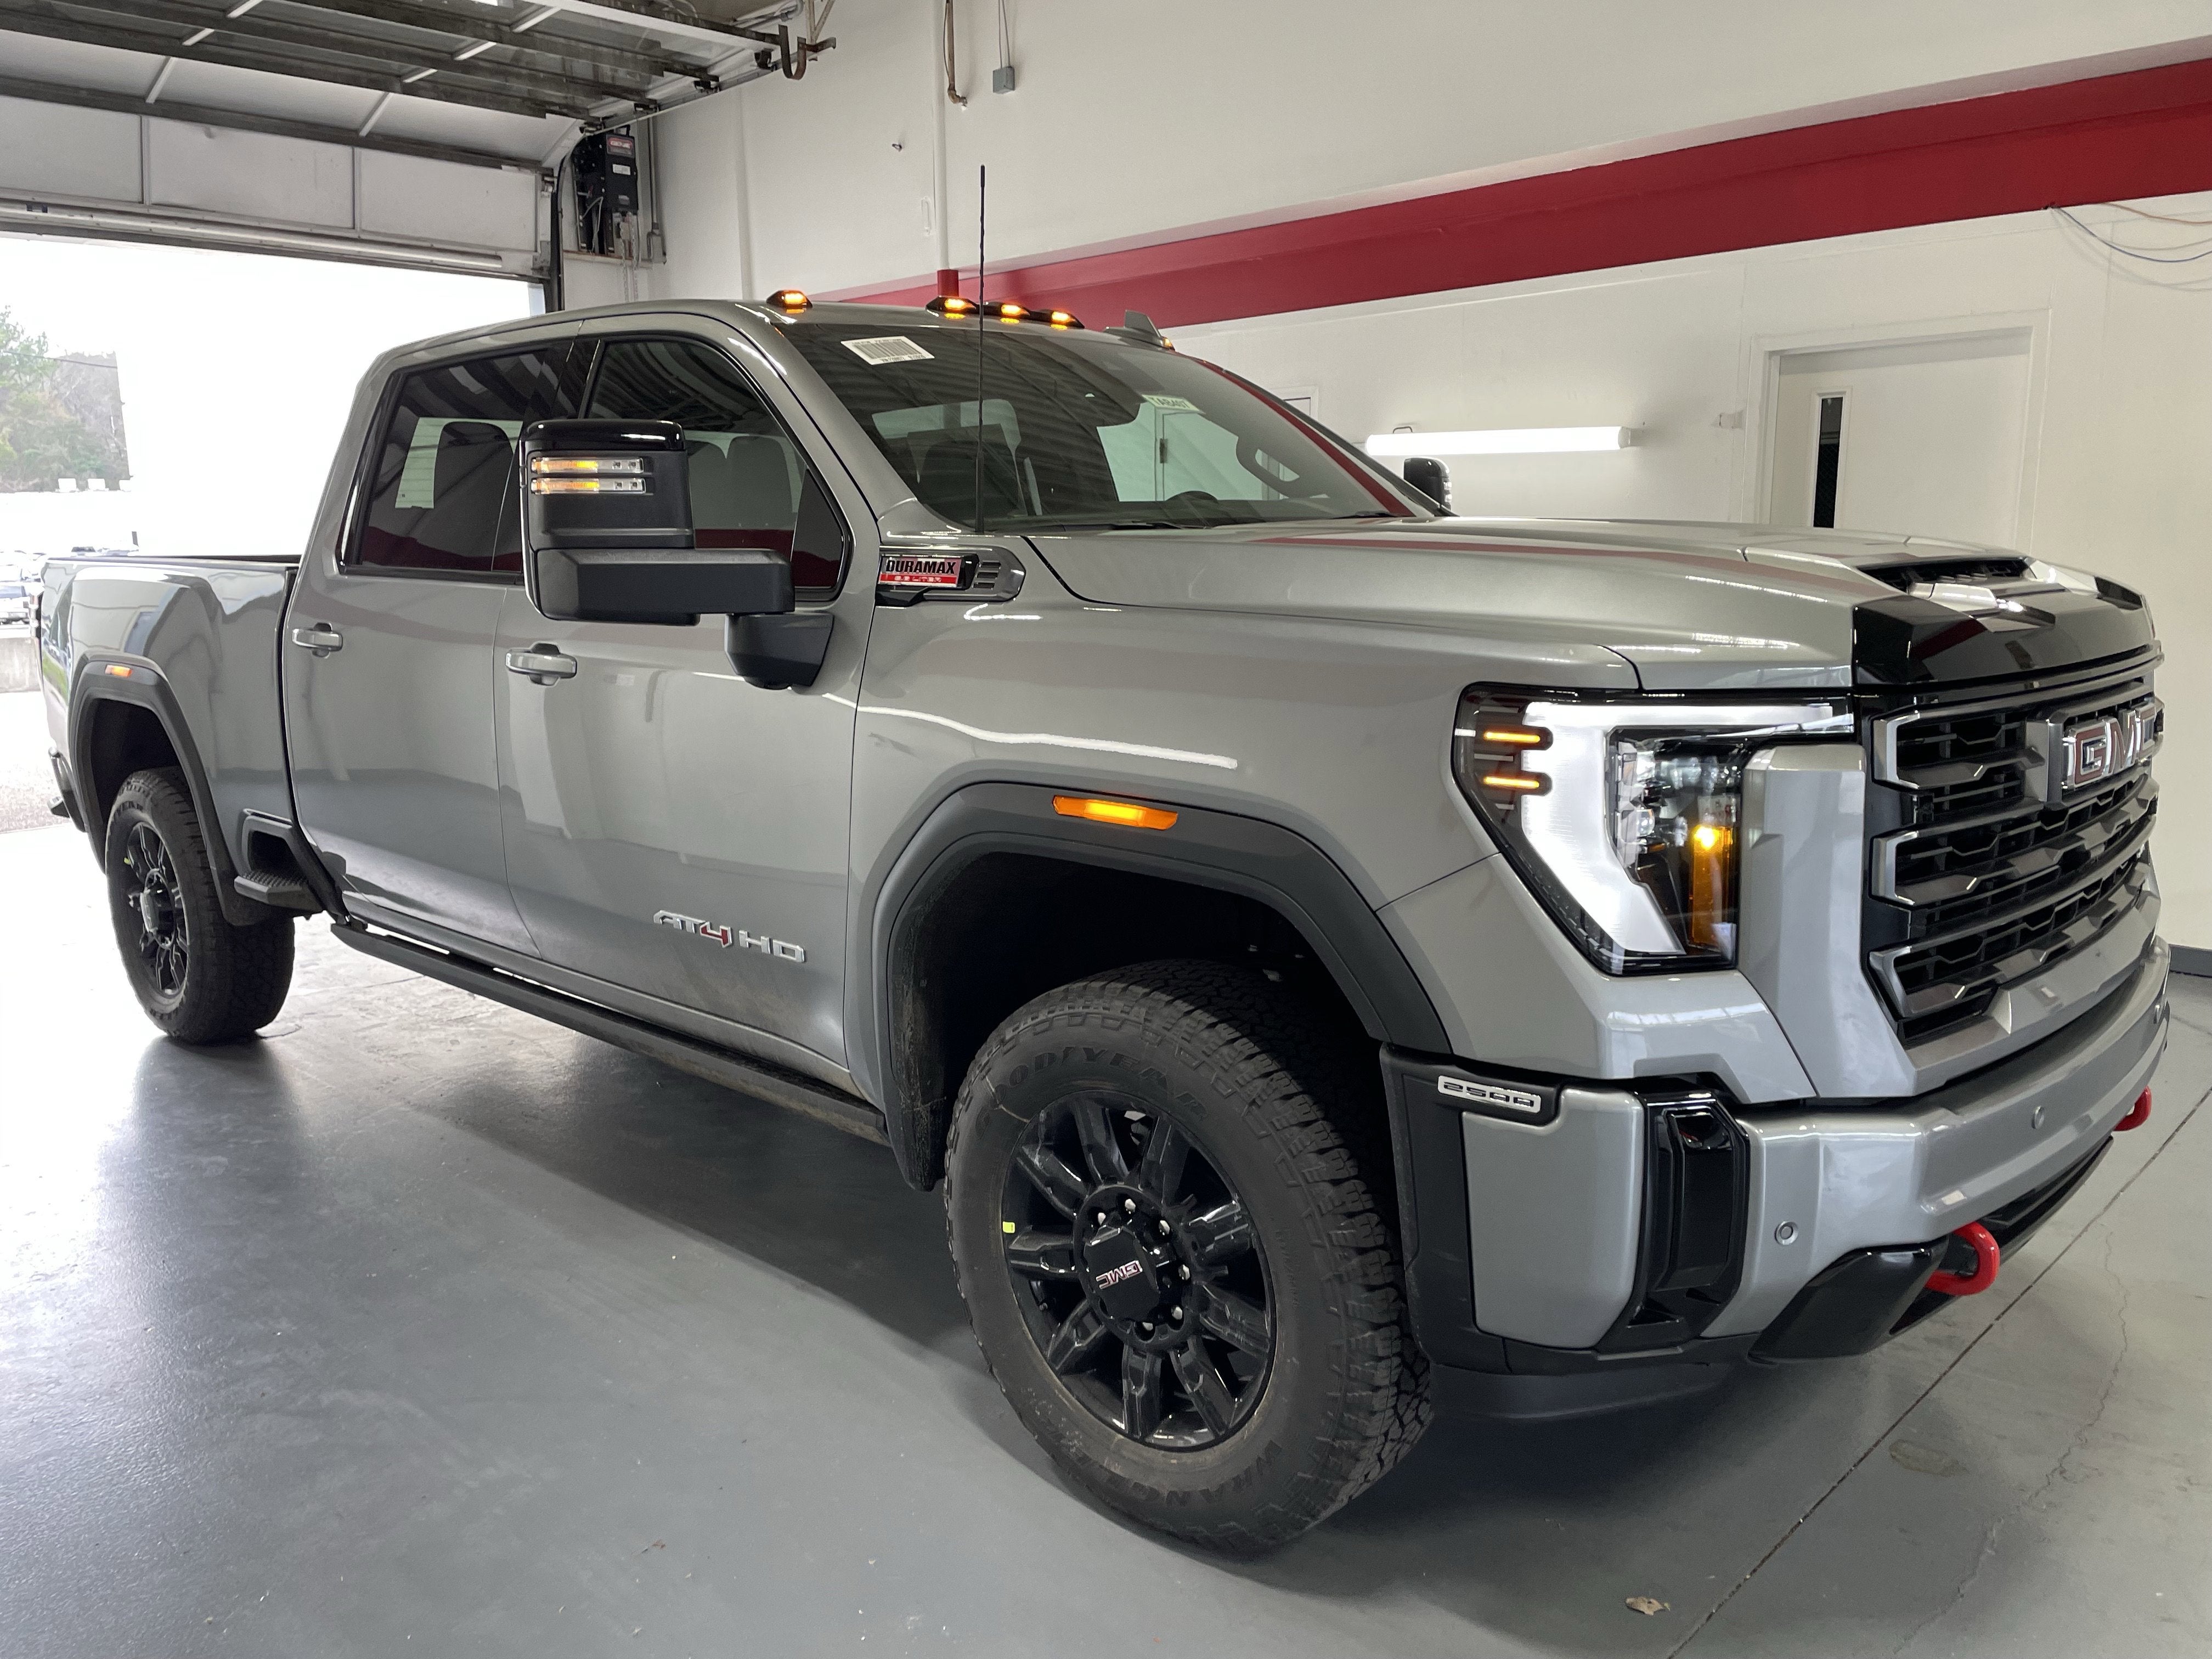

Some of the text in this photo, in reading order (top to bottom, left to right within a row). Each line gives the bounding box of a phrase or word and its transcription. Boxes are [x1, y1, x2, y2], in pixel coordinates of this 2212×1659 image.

[885, 560, 956, 574] DURAMAX
[2067, 702, 2157, 788] GMC
[1443, 1081, 1535, 1109] 2500
[1096, 1260, 1143, 1290] GMC
